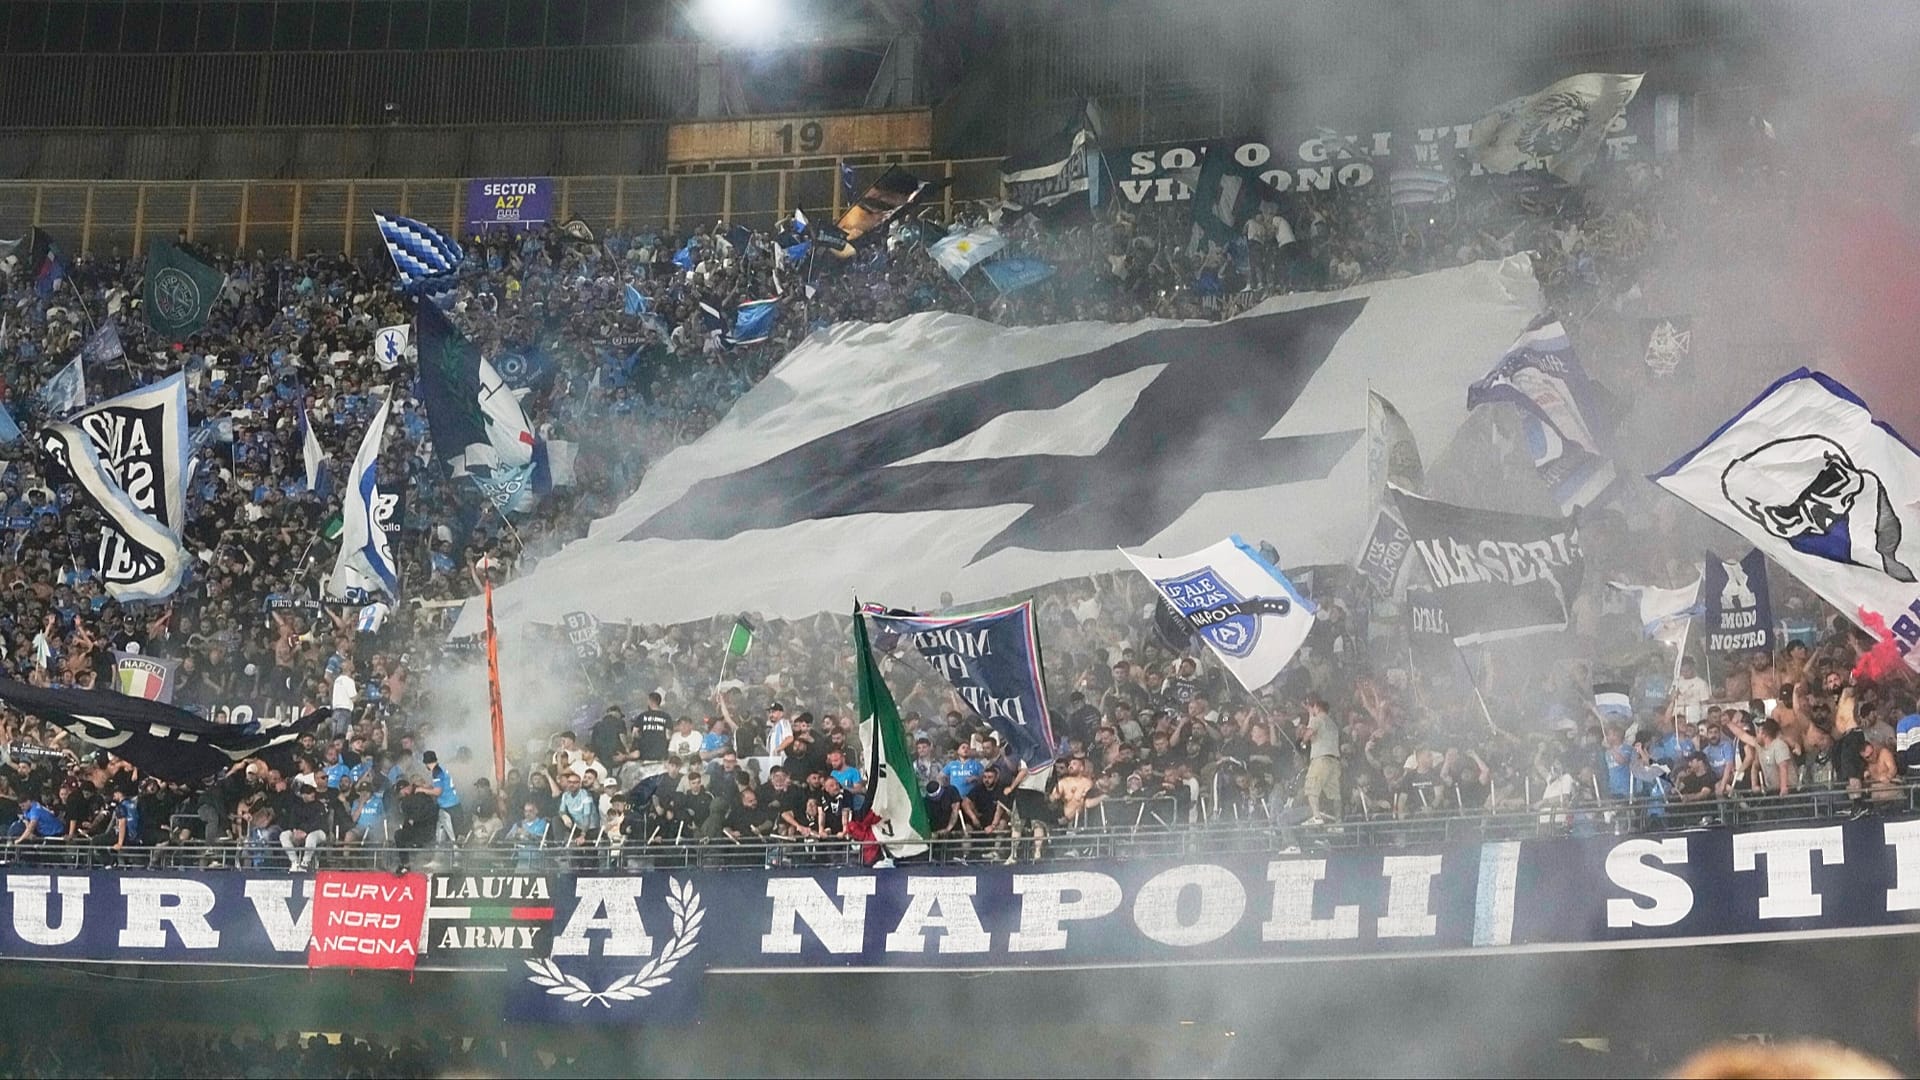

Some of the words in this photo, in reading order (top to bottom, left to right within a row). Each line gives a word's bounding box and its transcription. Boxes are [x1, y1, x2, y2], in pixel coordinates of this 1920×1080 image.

[776, 121, 824, 153] 19
[1131, 143, 1271, 175] SOO
[484, 183, 537, 196] SECTOR
[1119, 163, 1375, 204] VIONO
[495, 195, 524, 209] A27
[1190, 603, 1242, 626] NAPOLI
[1710, 629, 1767, 651] NOSTRO
[124, 660, 161, 675] NAPOLI
[322, 882, 414, 902] CURVA
[435, 876, 550, 900] LAUTA
[552, 877, 653, 957] A
[761, 855, 1443, 955] NAPOLI
[327, 910, 401, 929] NORD
[310, 935, 416, 955] ANCONA
[437, 925, 542, 950] ARMY
